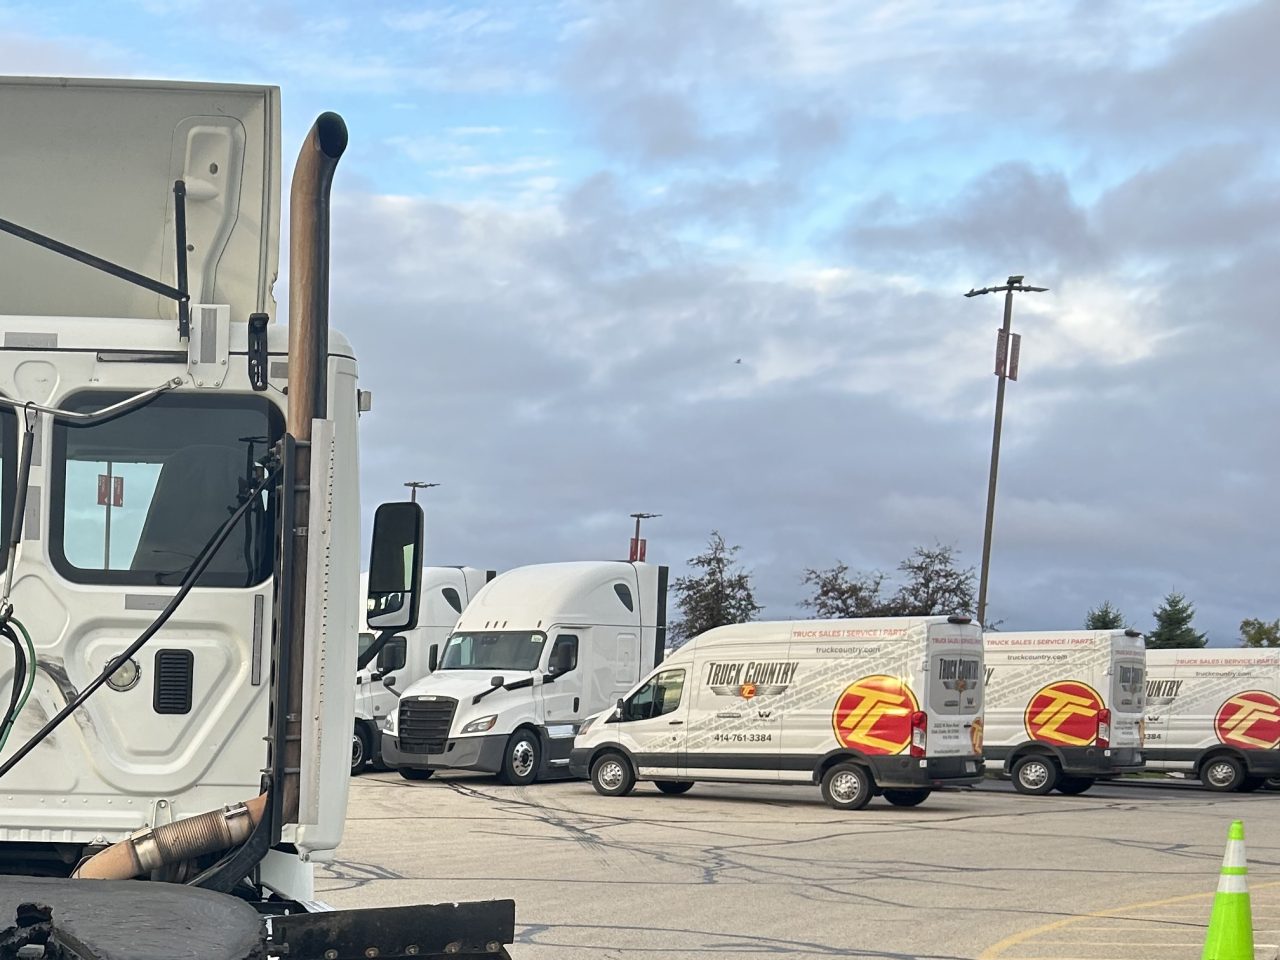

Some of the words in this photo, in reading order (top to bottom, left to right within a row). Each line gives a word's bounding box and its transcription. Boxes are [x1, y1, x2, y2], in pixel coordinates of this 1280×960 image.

[816, 646, 881, 655] truckcountry.com
[1007, 654, 1068, 662] truckcountry.com
[706, 662, 744, 686] TRUCK
[743, 661, 800, 685] COUNTRY
[714, 734, 772, 742] 414-761-3384
